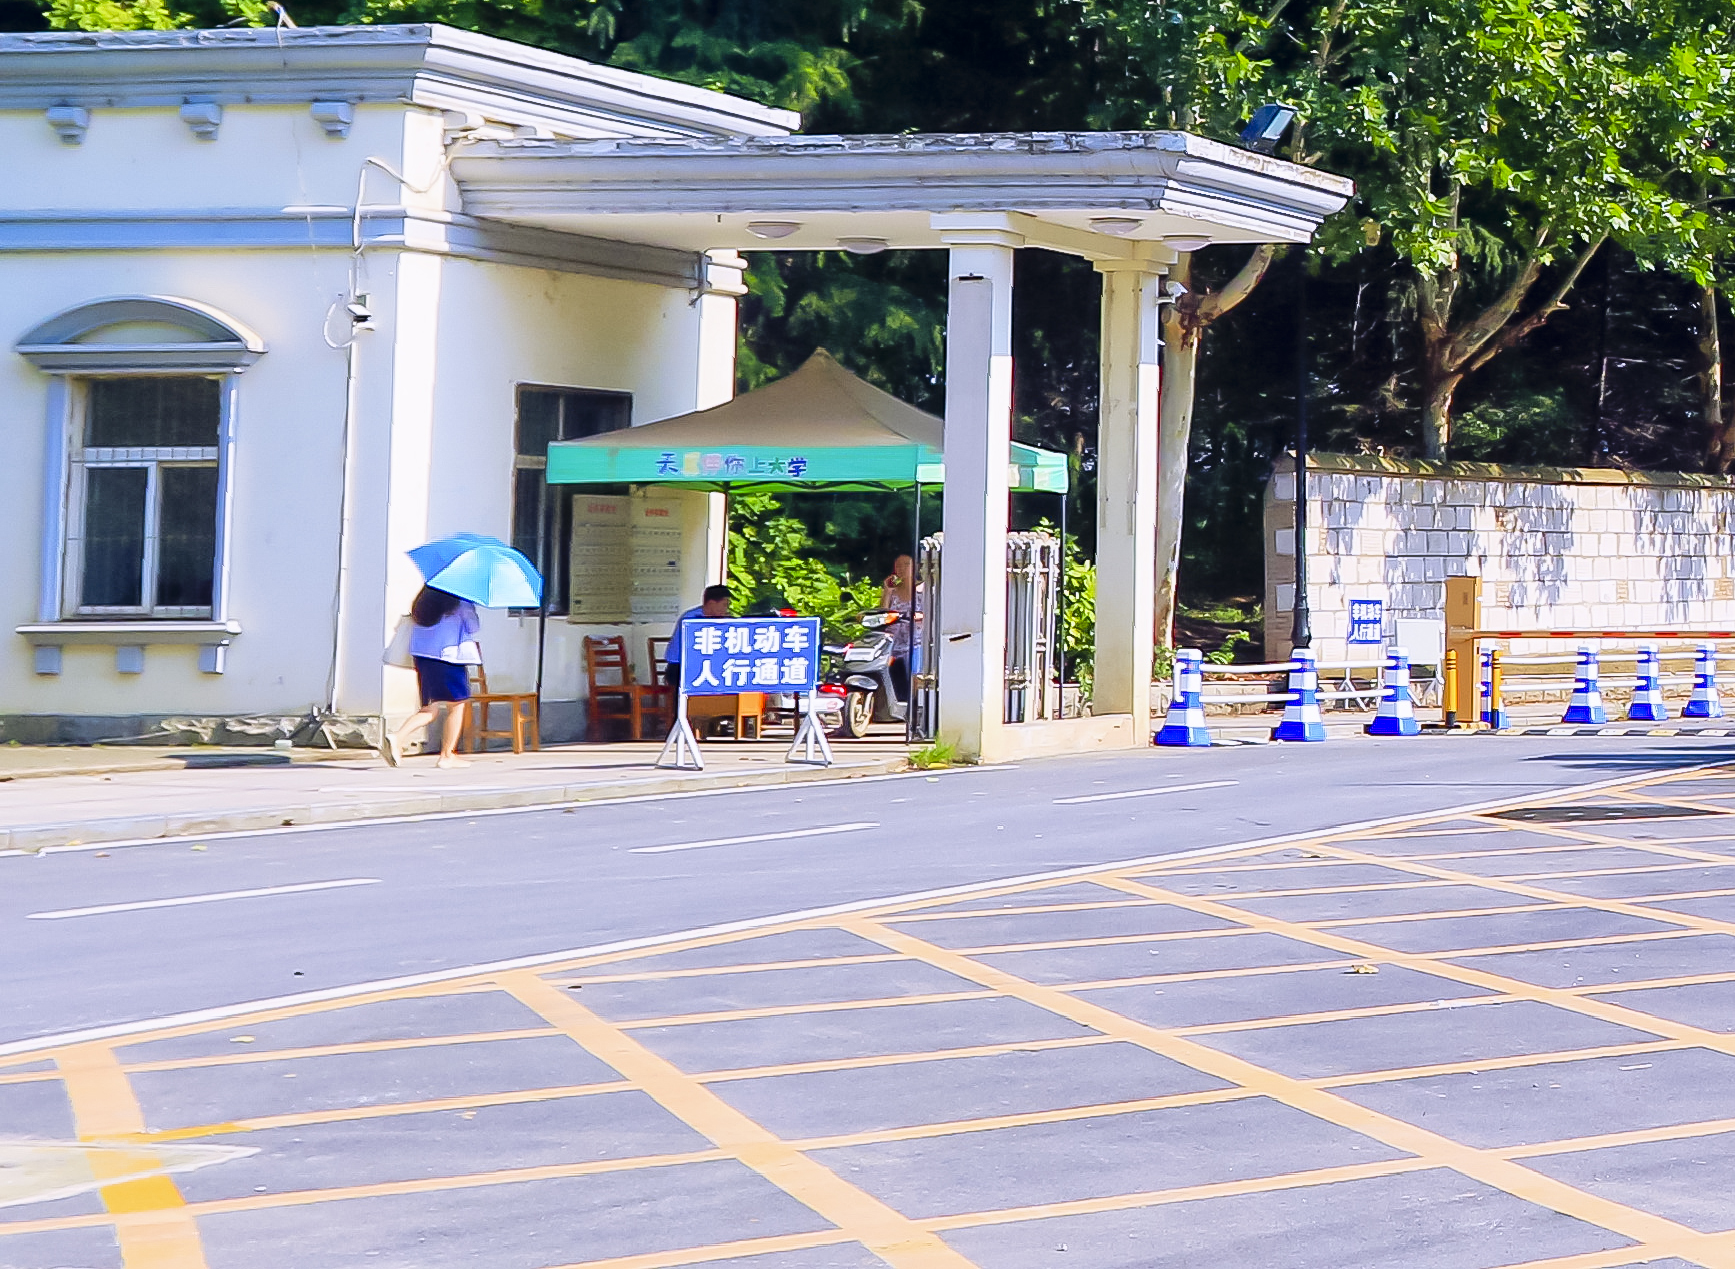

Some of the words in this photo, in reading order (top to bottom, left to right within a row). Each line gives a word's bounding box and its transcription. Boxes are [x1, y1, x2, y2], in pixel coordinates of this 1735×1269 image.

[693, 625, 810, 655] 非机动车
[692, 657, 810, 687] 人行通道
